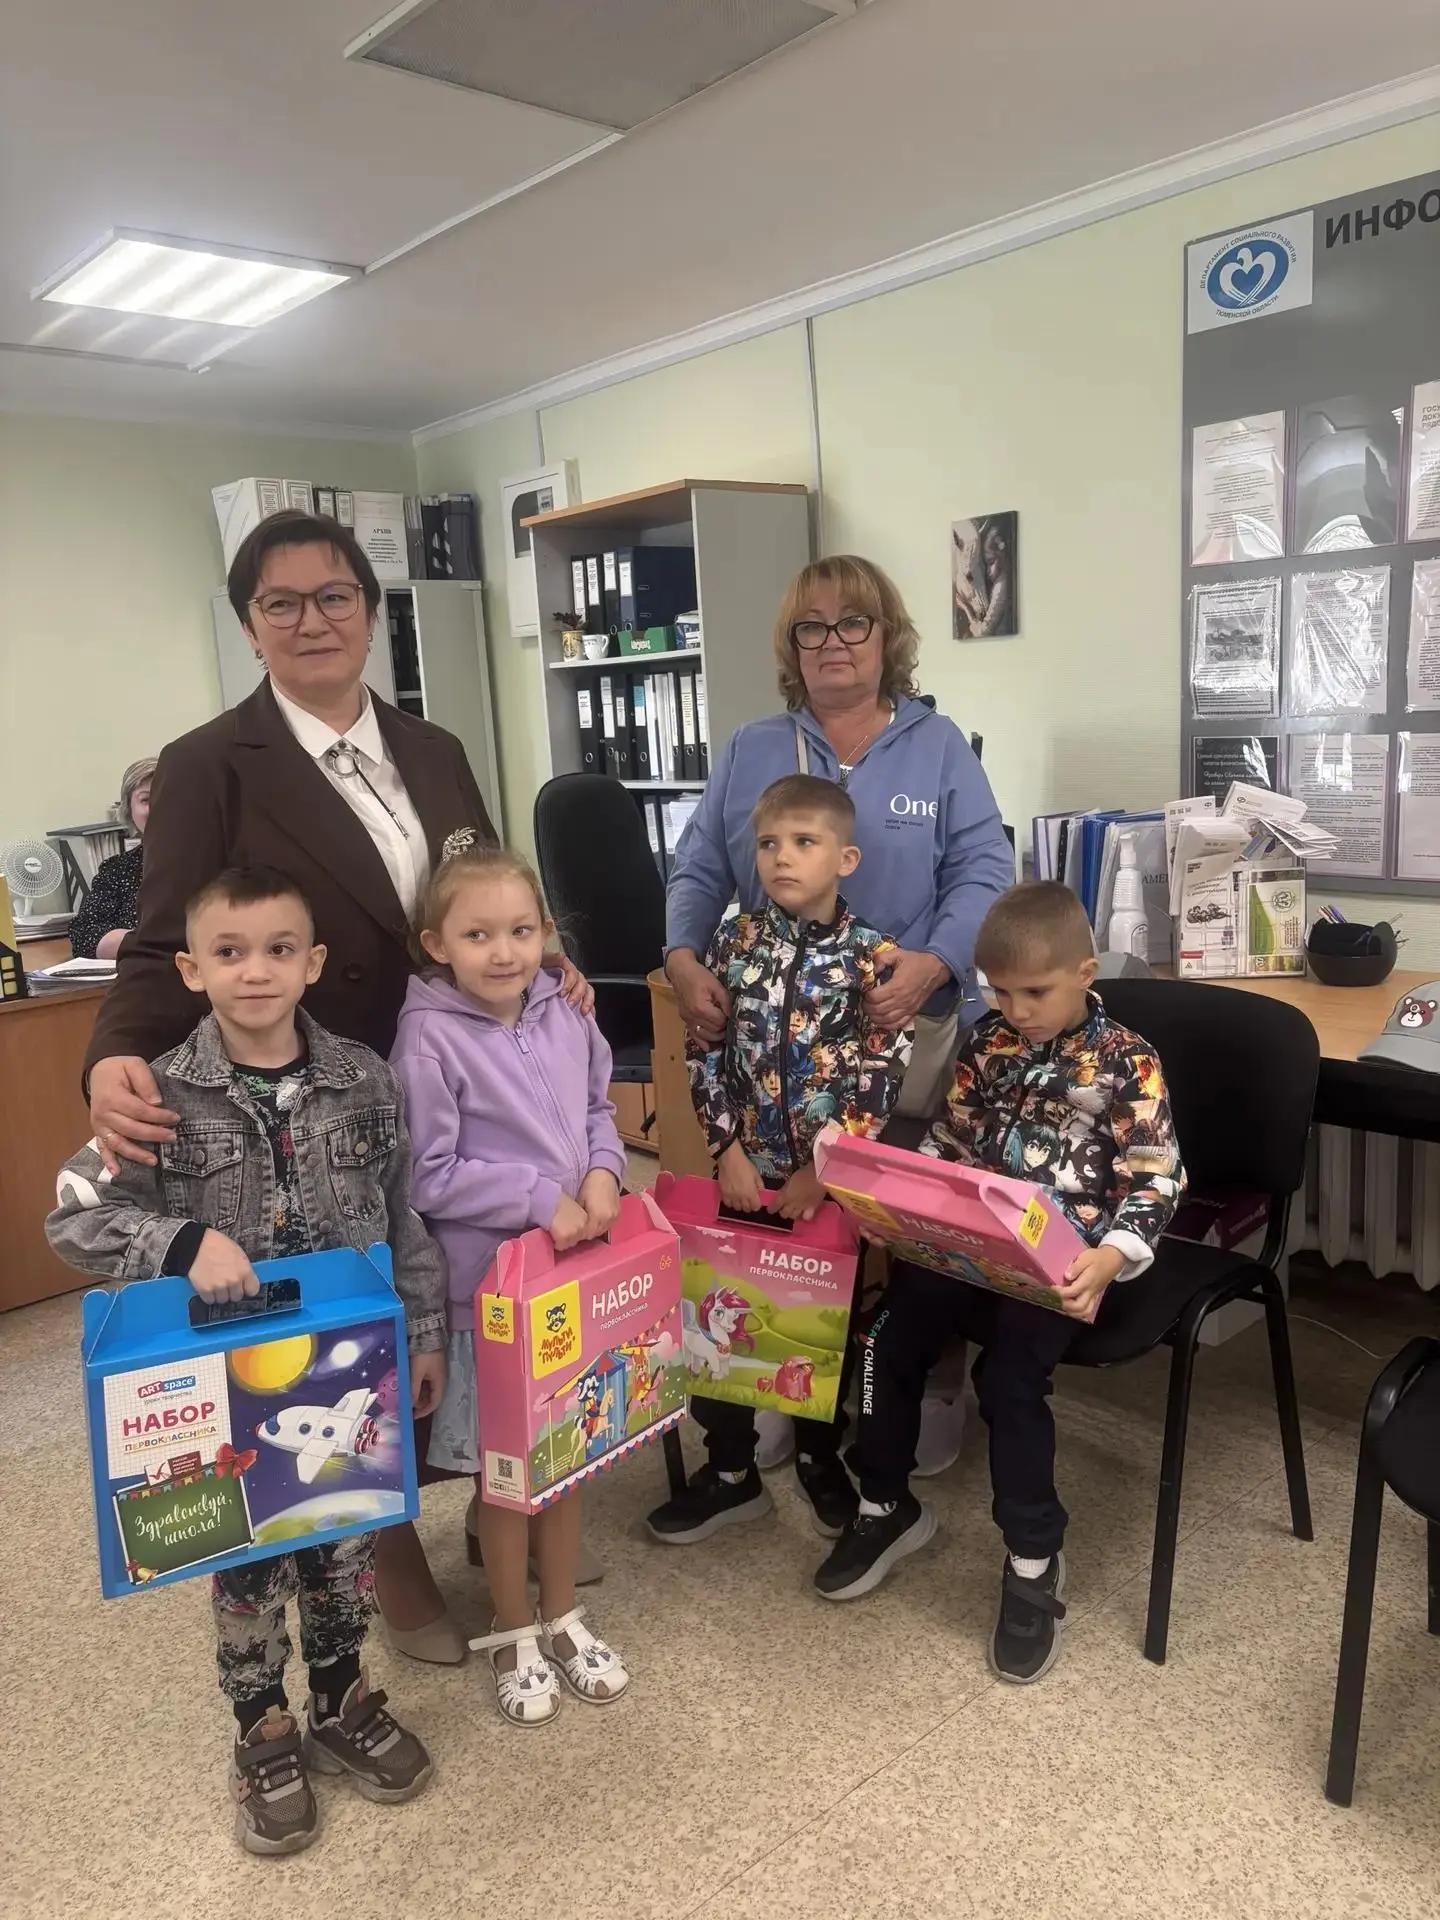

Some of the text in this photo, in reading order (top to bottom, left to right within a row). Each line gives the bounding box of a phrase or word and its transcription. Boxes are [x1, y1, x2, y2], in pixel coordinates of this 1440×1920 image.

[1326, 189, 1440, 249] ИНФО
[1200, 231, 1297, 289] ДЕПАРТАМЕНТ СОЦИАЛЬНОГО РАЗВИТИЯ
[1216, 295, 1280, 319] ТЮМЕНСКОЙ ОБЛАСТИ
[749, 1266, 838, 1290] ПЕРВОКЛАССНИКА
[760, 1249, 833, 1276] НАБОР
[592, 1273, 653, 1319] НАБОР
[600, 1302, 649, 1331] первоклассника
[863, 1310, 890, 1416] OCEAN CHALLENGE
[123, 1401, 216, 1437] НАБОР
[125, 1425, 217, 1452] ПЕРВОКЛАССНИКА
[135, 1491, 233, 1542] Здравствуй,
[164, 1507, 221, 1547] школа!
